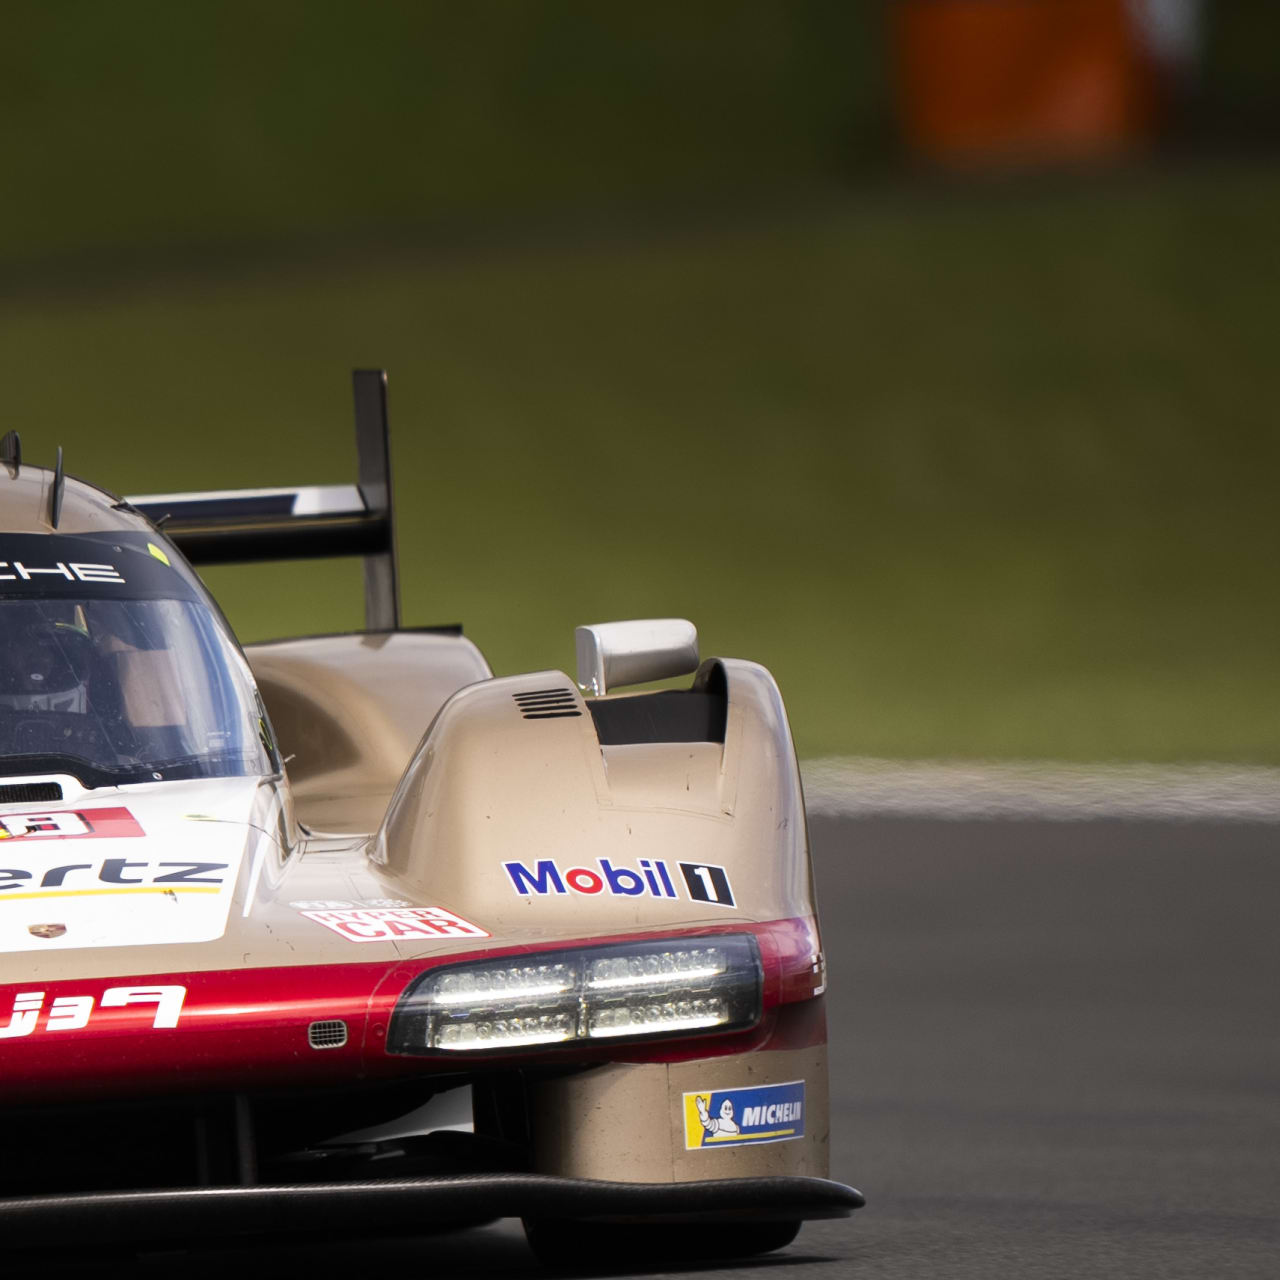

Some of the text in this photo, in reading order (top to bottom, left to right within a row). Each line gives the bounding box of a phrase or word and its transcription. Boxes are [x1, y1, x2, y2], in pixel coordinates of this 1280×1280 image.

[504, 858, 675, 898] Mobil
[312, 909, 441, 922] HYPER
[335, 918, 476, 938] CAR
[742, 1102, 801, 1126] MICHELIN
